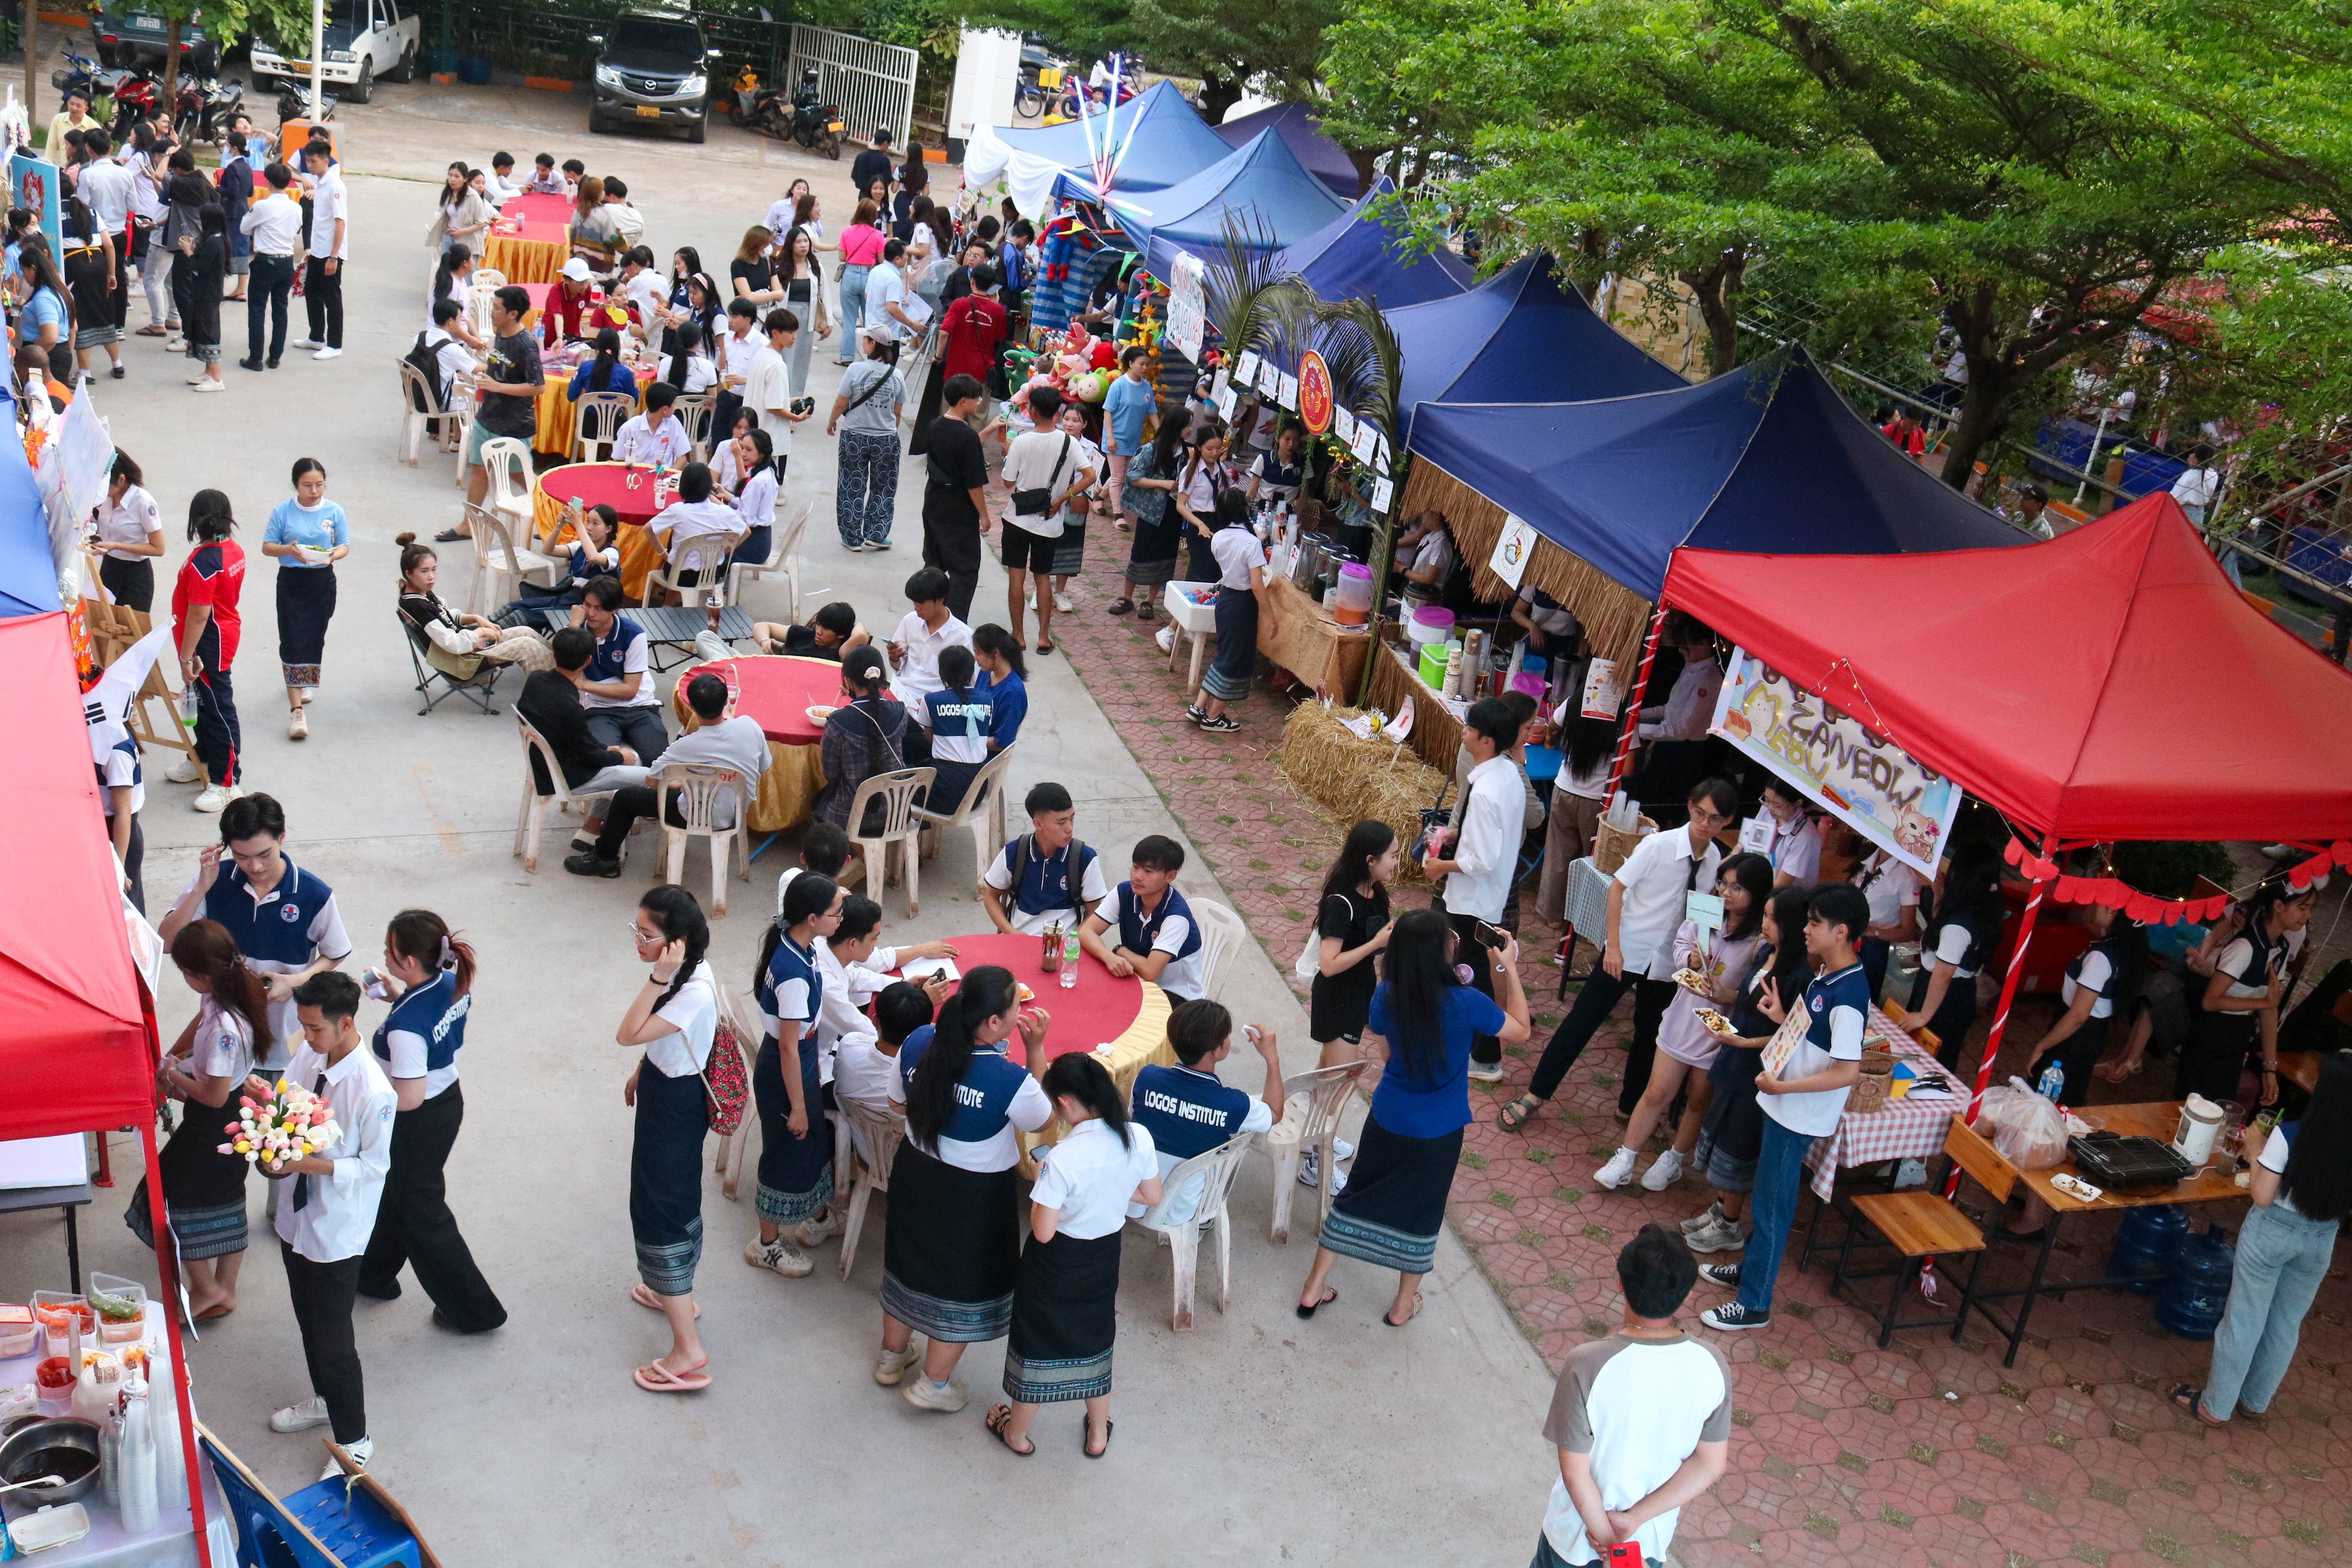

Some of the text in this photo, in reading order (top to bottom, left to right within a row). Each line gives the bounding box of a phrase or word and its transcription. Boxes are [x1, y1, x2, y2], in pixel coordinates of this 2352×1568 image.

[1318, 373, 1328, 398] JENG
[936, 704, 960, 717] LOGOS
[1145, 1089, 1228, 1127] LOGOS INSTITUTE
